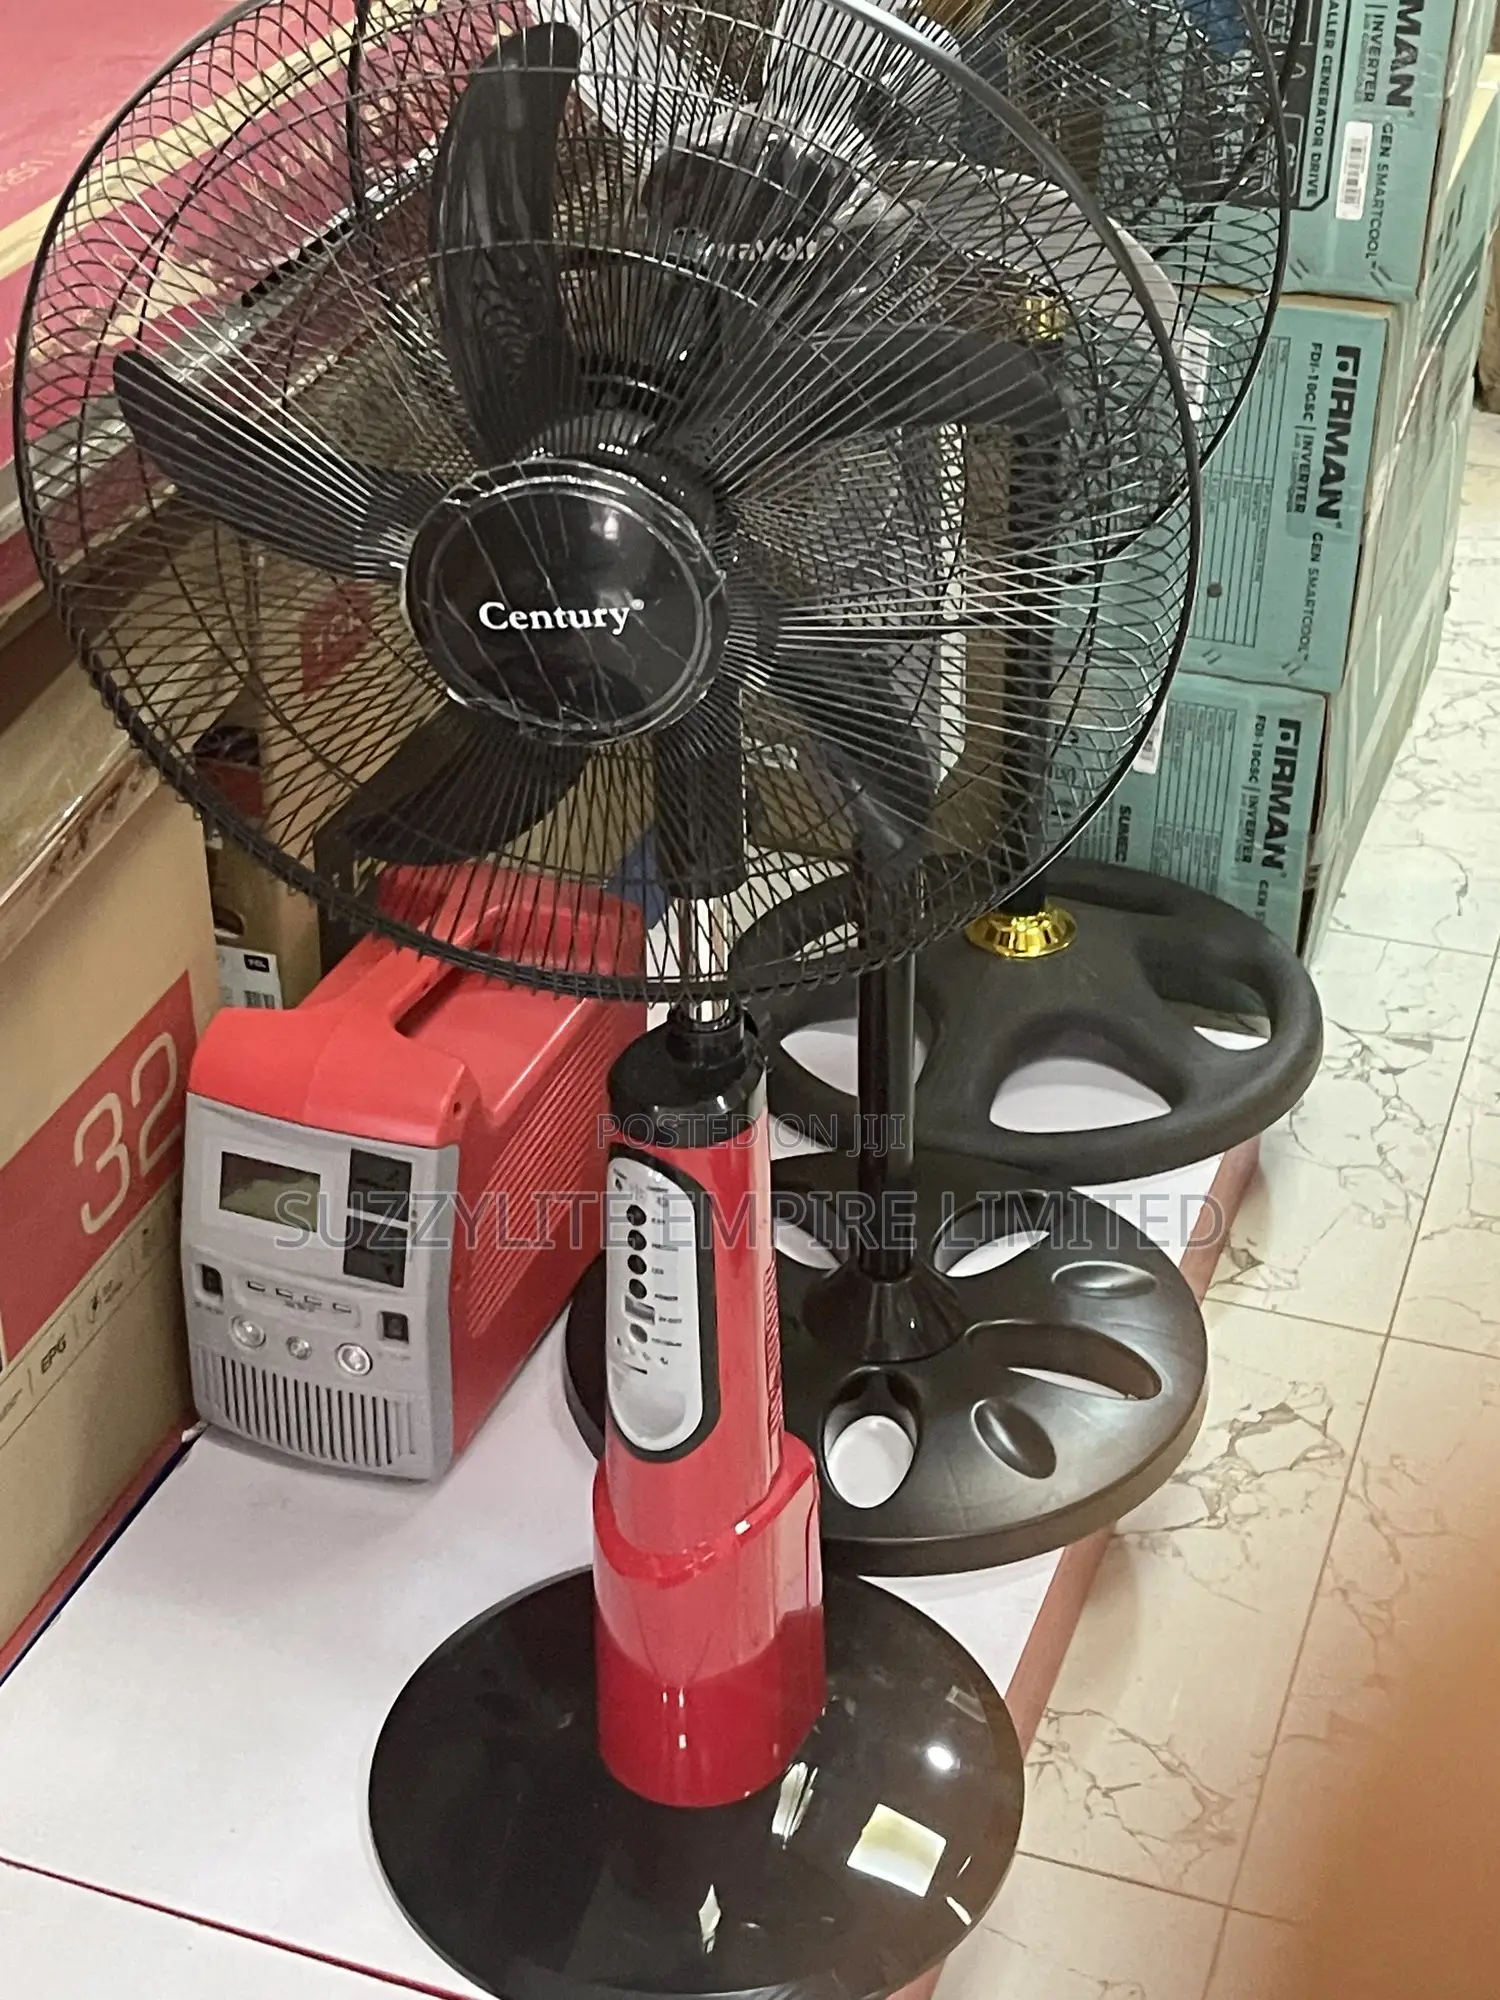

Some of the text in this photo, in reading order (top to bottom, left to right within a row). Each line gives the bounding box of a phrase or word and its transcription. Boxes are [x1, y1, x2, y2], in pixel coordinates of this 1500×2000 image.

[1364, 14, 1386, 103] INVERTER
[1310, 55, 1333, 149] GENERATOR
[1380, 122, 1394, 157] GEN
[1306, 153, 1321, 198] DRIVE
[1294, 435, 1315, 514] INVERTER
[1316, 345, 1361, 520] FIRMAN
[1309, 532, 1324, 563] GEN
[1242, 795, 1260, 864] INVERTER
[1261, 717, 1301, 870] FIRMAN
[74, 1031, 183, 1235] 32
